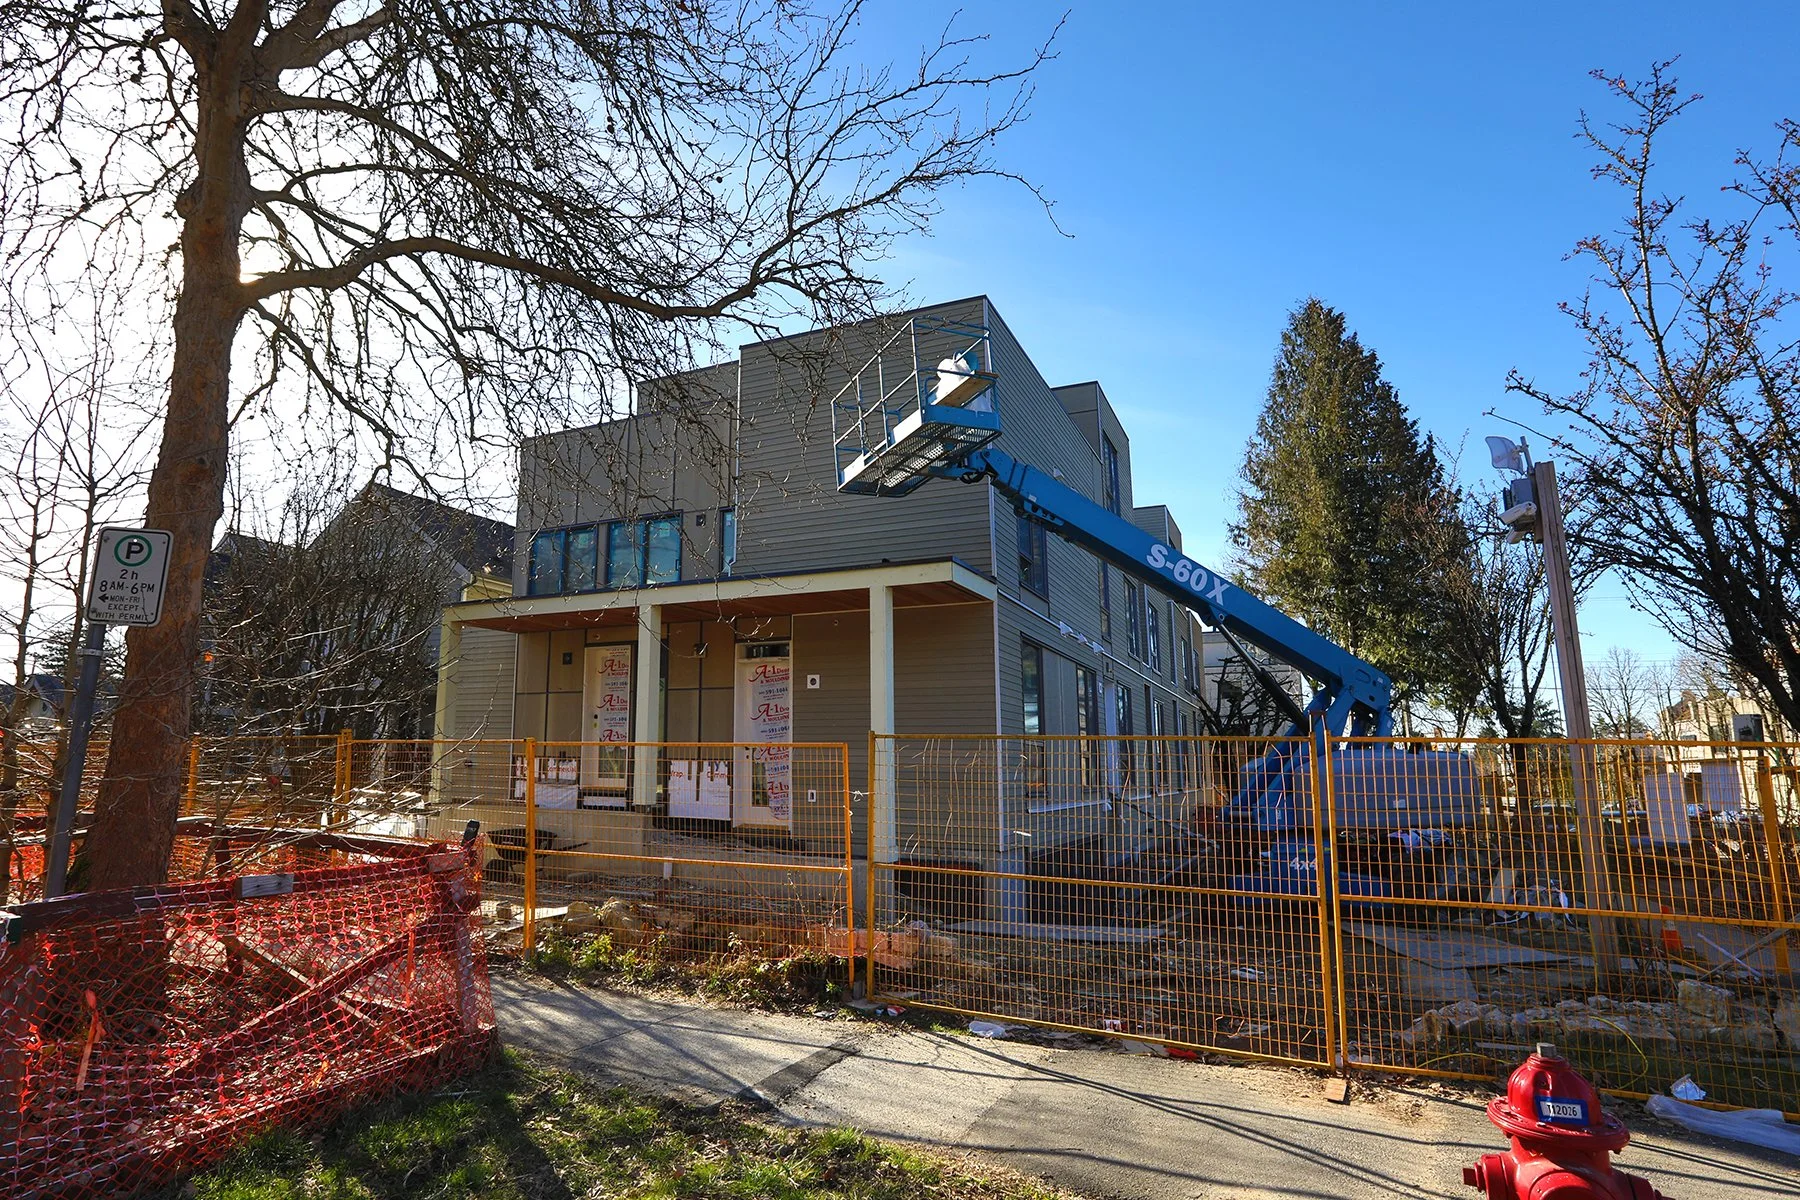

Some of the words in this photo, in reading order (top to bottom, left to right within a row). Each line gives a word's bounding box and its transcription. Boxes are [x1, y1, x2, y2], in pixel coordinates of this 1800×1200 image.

[125, 541, 144, 560] P
[120, 568, 128, 580] 2
[131, 570, 138, 580] h
[1146, 543, 1230, 606] S-60X
[107, 603, 140, 612] EXCEPT
[95, 611, 114, 620] WITH
[118, 612, 149, 621] PERMIT
